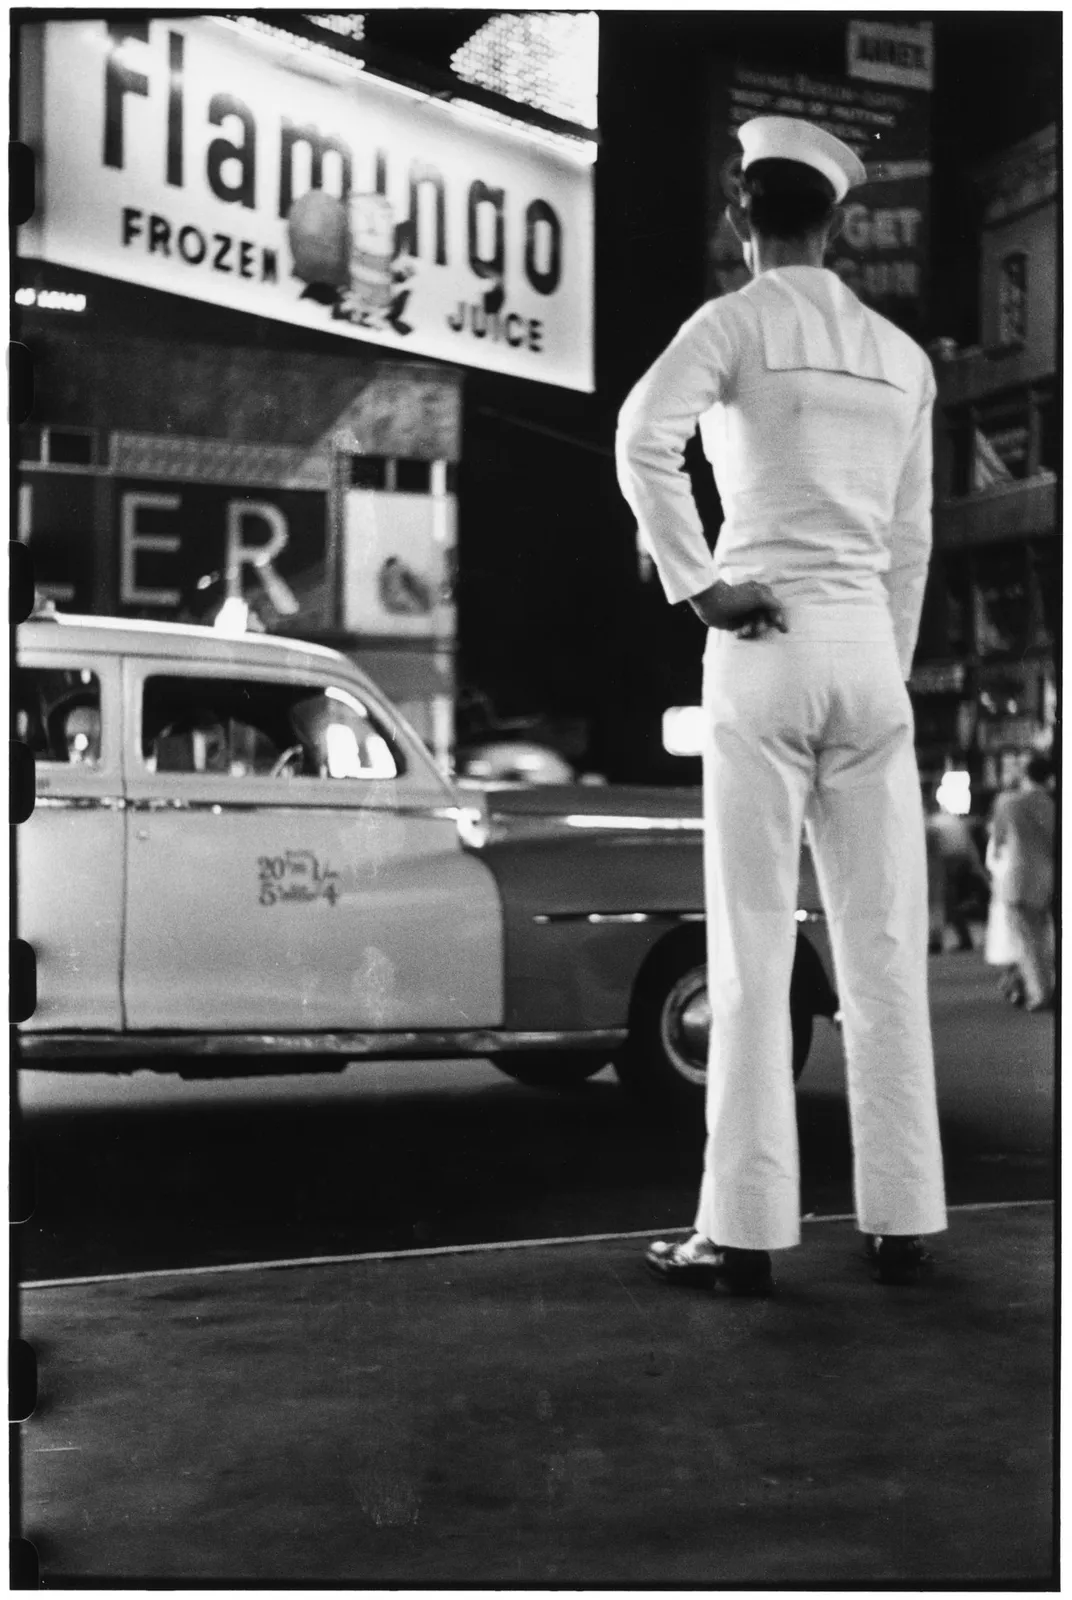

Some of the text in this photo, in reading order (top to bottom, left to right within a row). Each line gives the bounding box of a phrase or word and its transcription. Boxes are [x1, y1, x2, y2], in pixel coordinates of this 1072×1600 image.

[121, 206, 279, 284] FROZEN
[842, 202, 922, 250] GET
[447, 301, 544, 353] JUICE
[257, 855, 285, 881] 20
